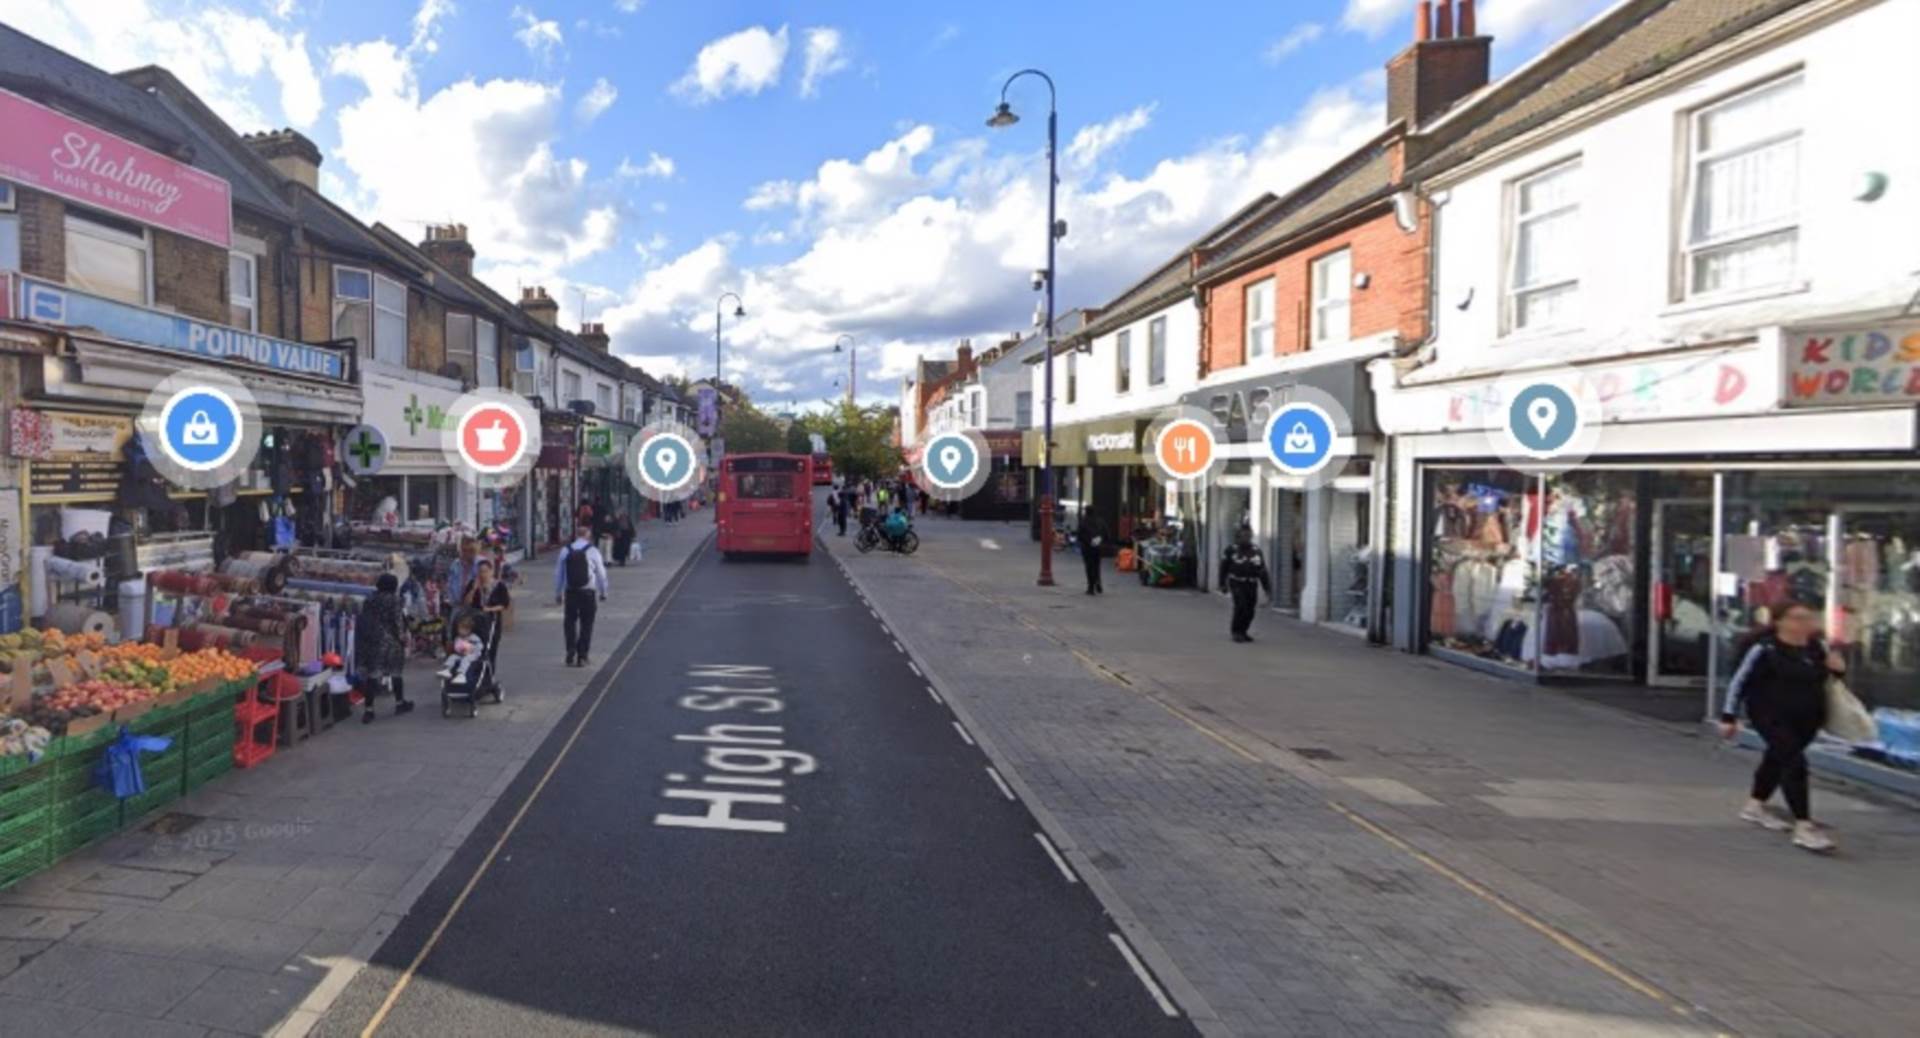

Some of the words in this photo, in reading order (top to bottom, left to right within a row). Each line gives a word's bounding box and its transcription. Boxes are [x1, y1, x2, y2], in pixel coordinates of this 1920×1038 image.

[53, 169, 89, 192] HAIR
[93, 181, 104, 197] &
[105, 186, 156, 213] BEAUTY
[189, 322, 272, 365] POUND
[275, 343, 332, 375] VALUE
[1800, 331, 1920, 364] KIDS
[1791, 365, 1920, 400] WORLD
